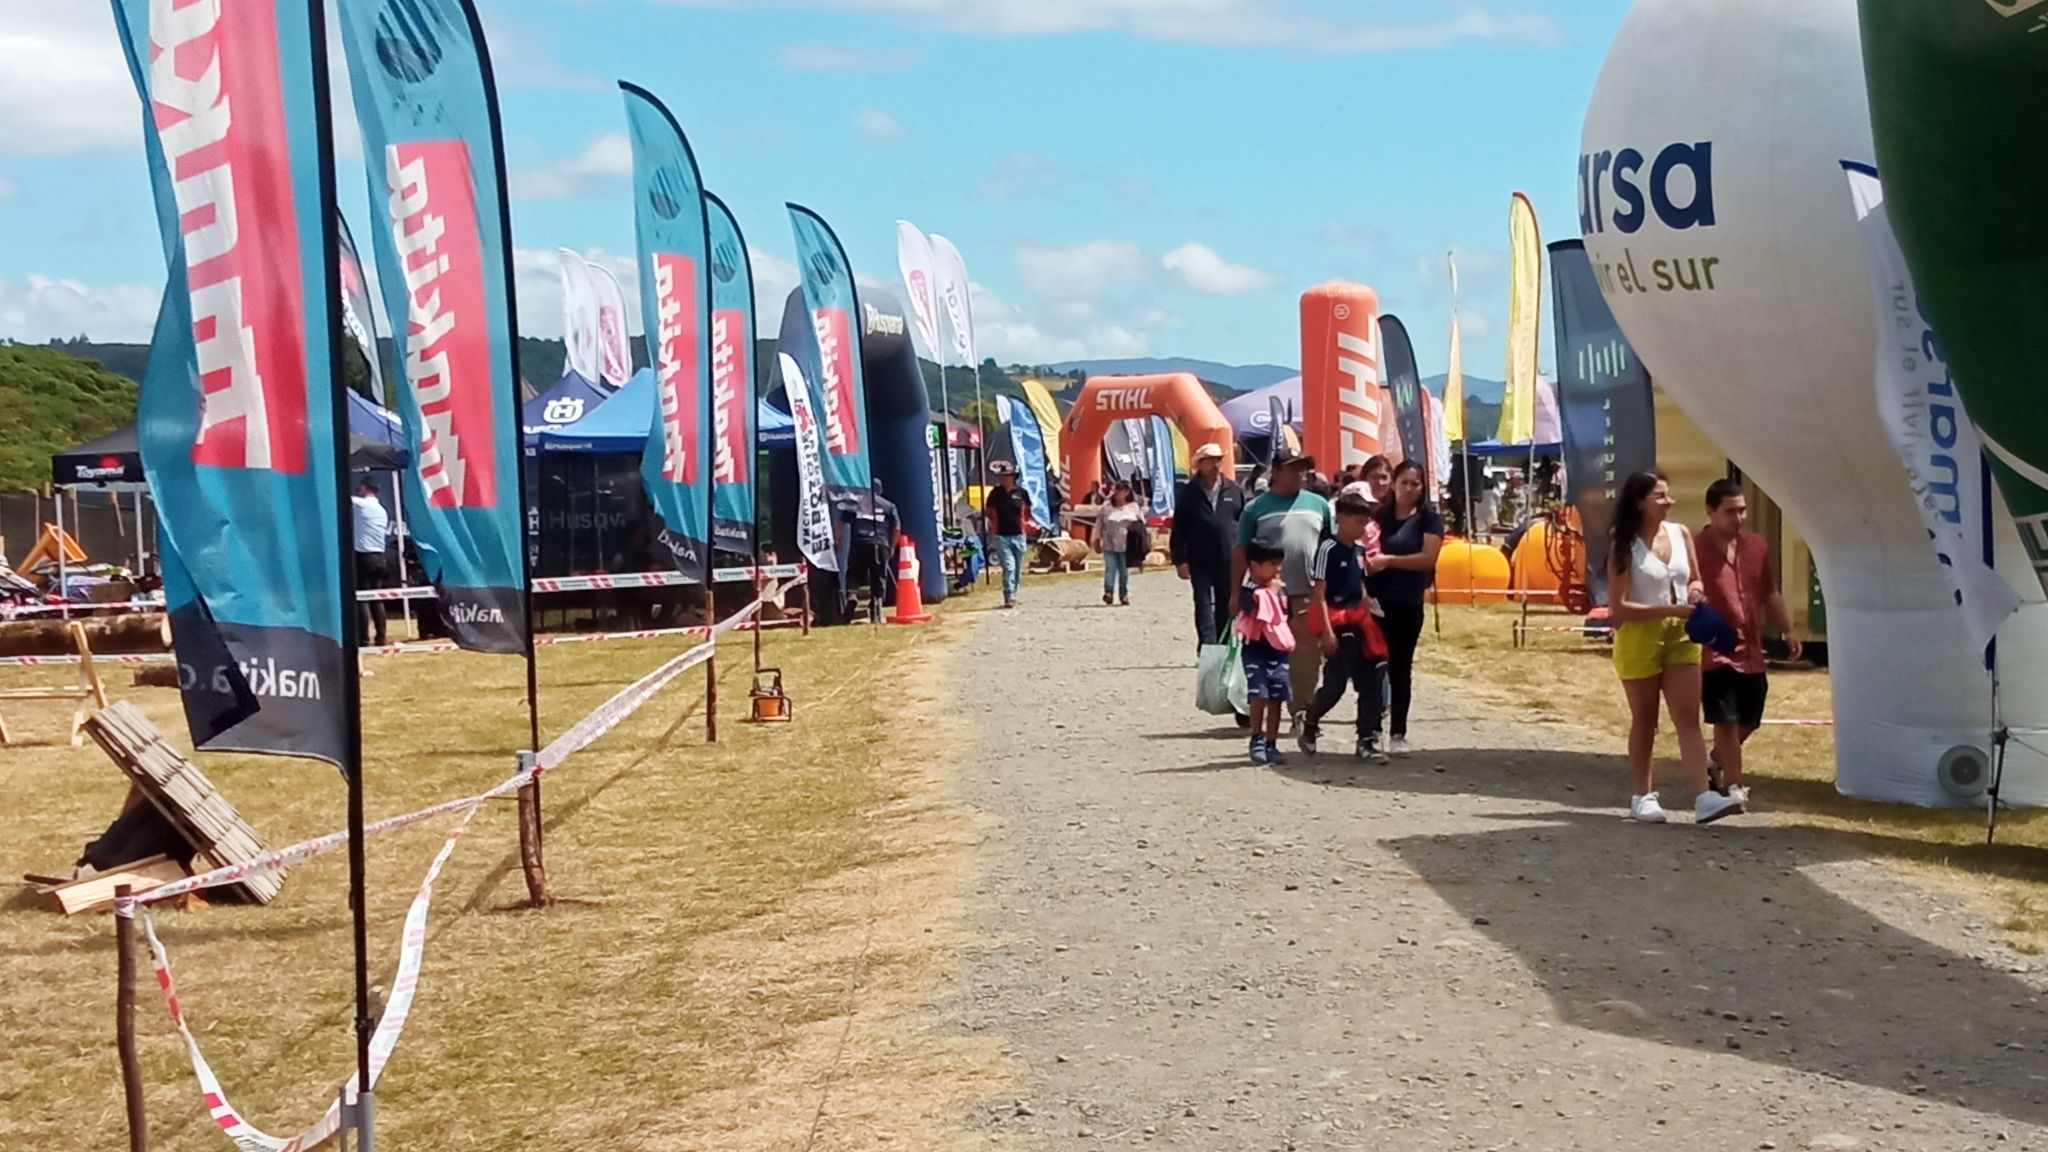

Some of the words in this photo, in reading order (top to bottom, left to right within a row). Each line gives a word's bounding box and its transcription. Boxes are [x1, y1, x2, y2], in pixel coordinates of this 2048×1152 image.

[1617, 248, 1647, 294] el
[1652, 255, 1720, 292] sur
[1095, 388, 1153, 411] STIHL
[1337, 312, 1379, 471] TIHL
